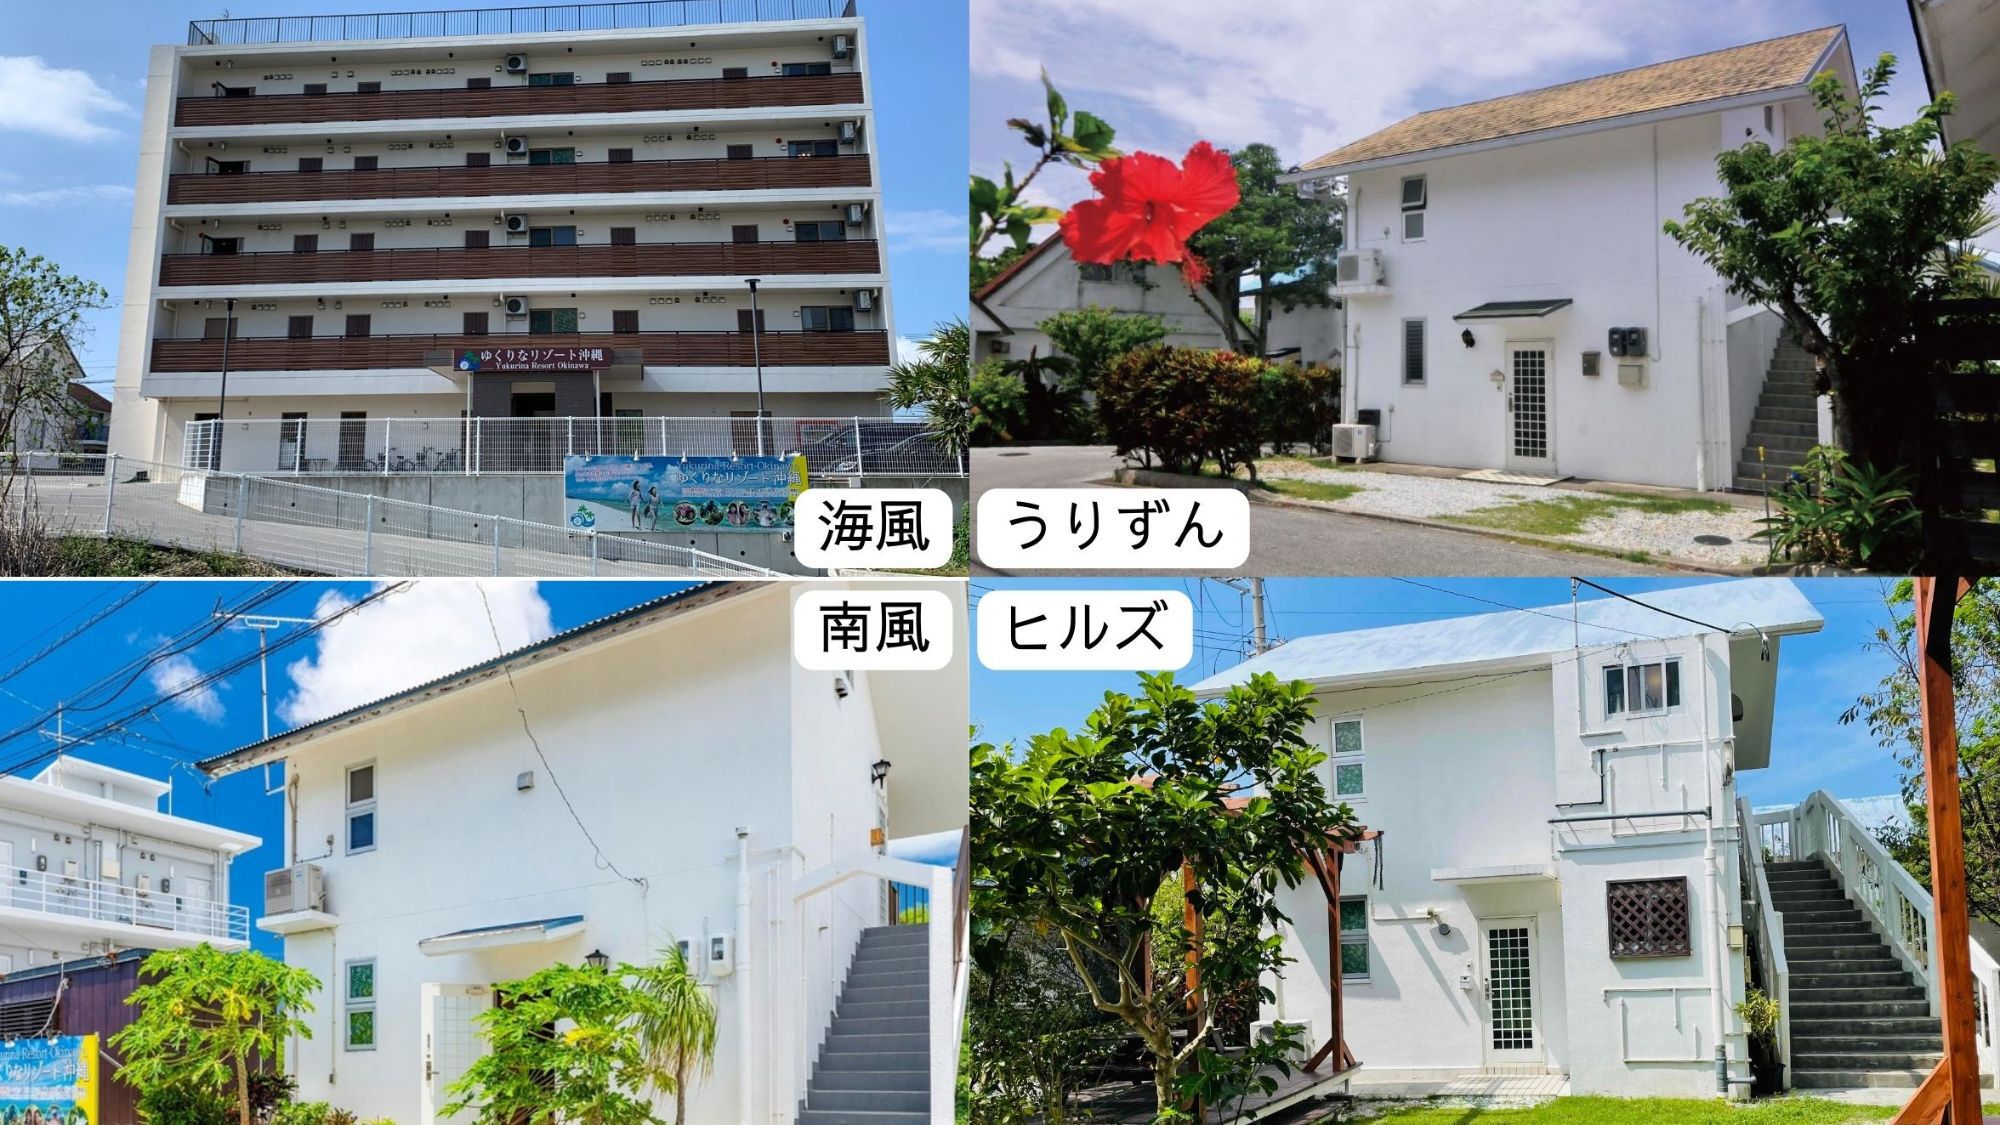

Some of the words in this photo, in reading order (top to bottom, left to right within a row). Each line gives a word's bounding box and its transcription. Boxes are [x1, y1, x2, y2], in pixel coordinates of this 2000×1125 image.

[480, 348, 604, 362] ゆくりなリゾート沖縄
[495, 361, 530, 370] Yukurina
[531, 361, 555, 370] Resort
[557, 361, 590, 370] Okinawa
[677, 471, 802, 486] ゆくりなリゾート沖縄
